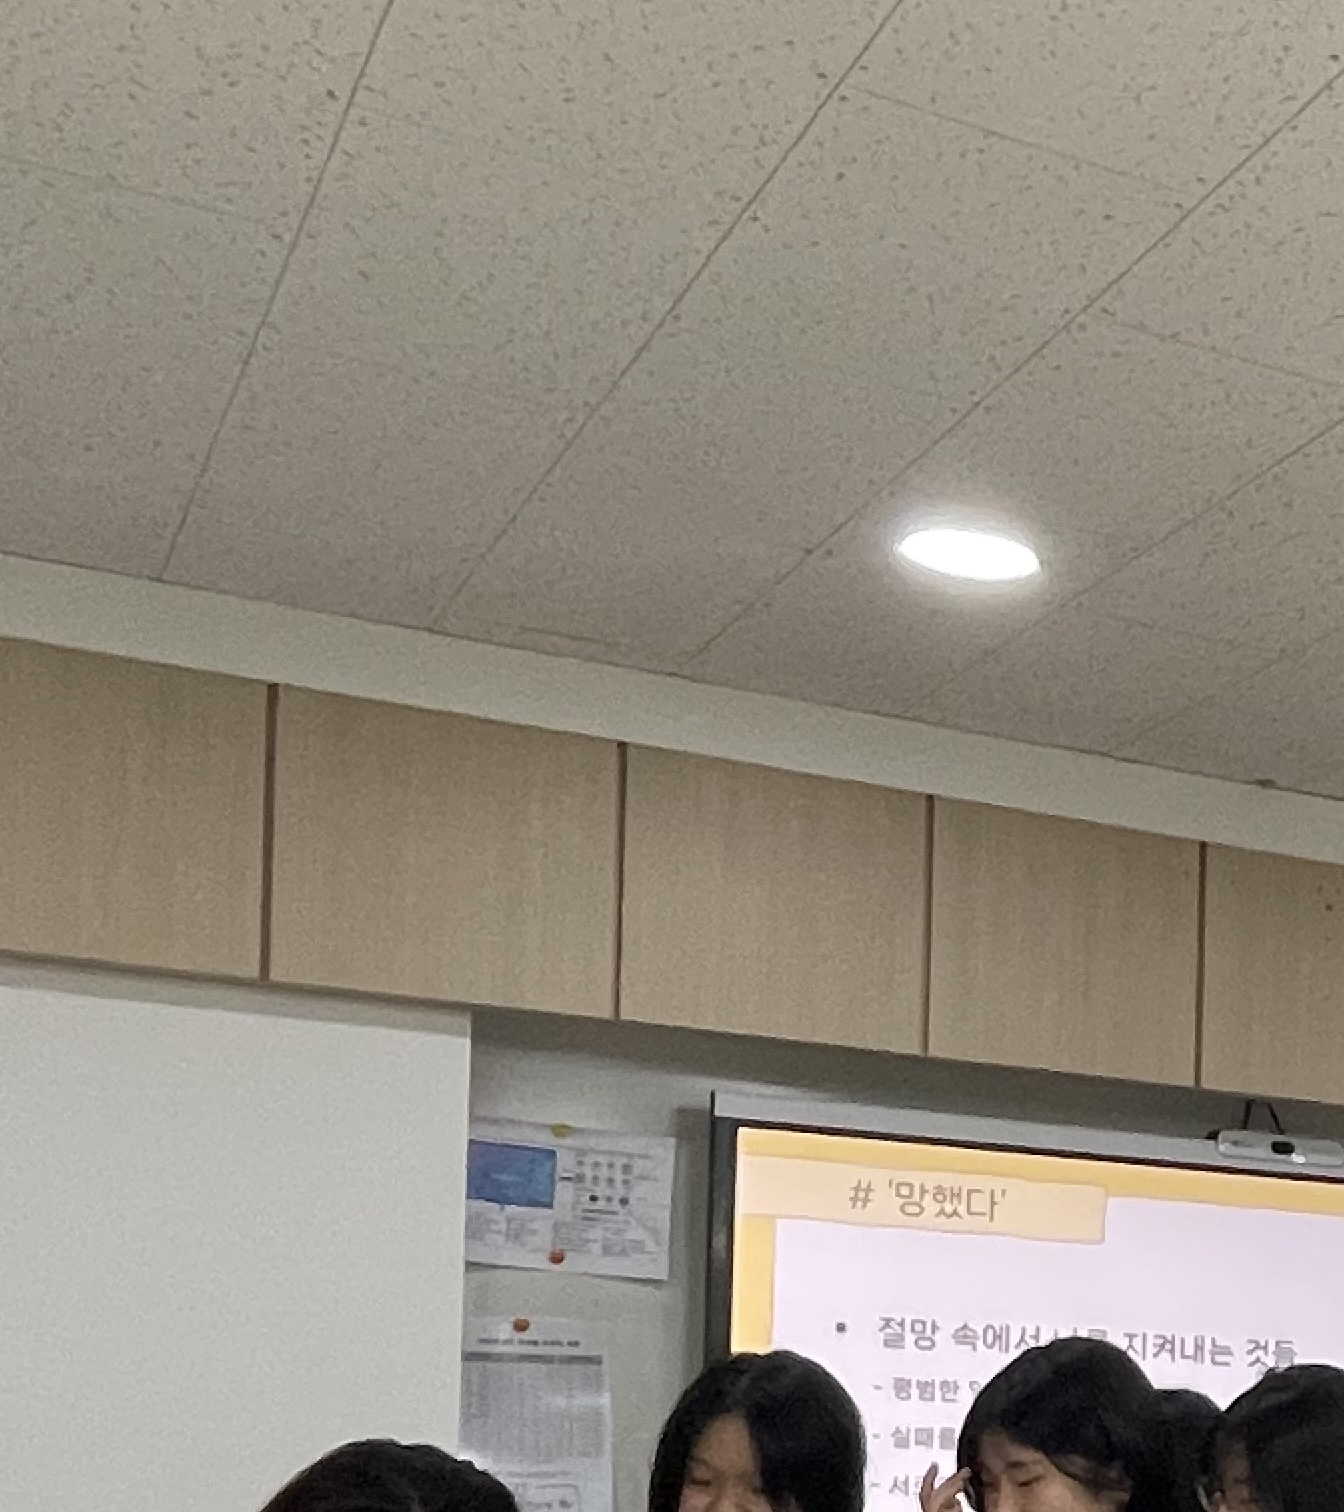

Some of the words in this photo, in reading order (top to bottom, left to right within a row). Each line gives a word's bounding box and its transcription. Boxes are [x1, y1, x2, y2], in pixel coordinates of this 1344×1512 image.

[849, 1179, 874, 1210] #
[888, 1178, 1007, 1223] '망했다'
[878, 1316, 941, 1351] 절망
[953, 1322, 1042, 1353] 속에서
[1124, 1332, 1234, 1367] 지켜내는
